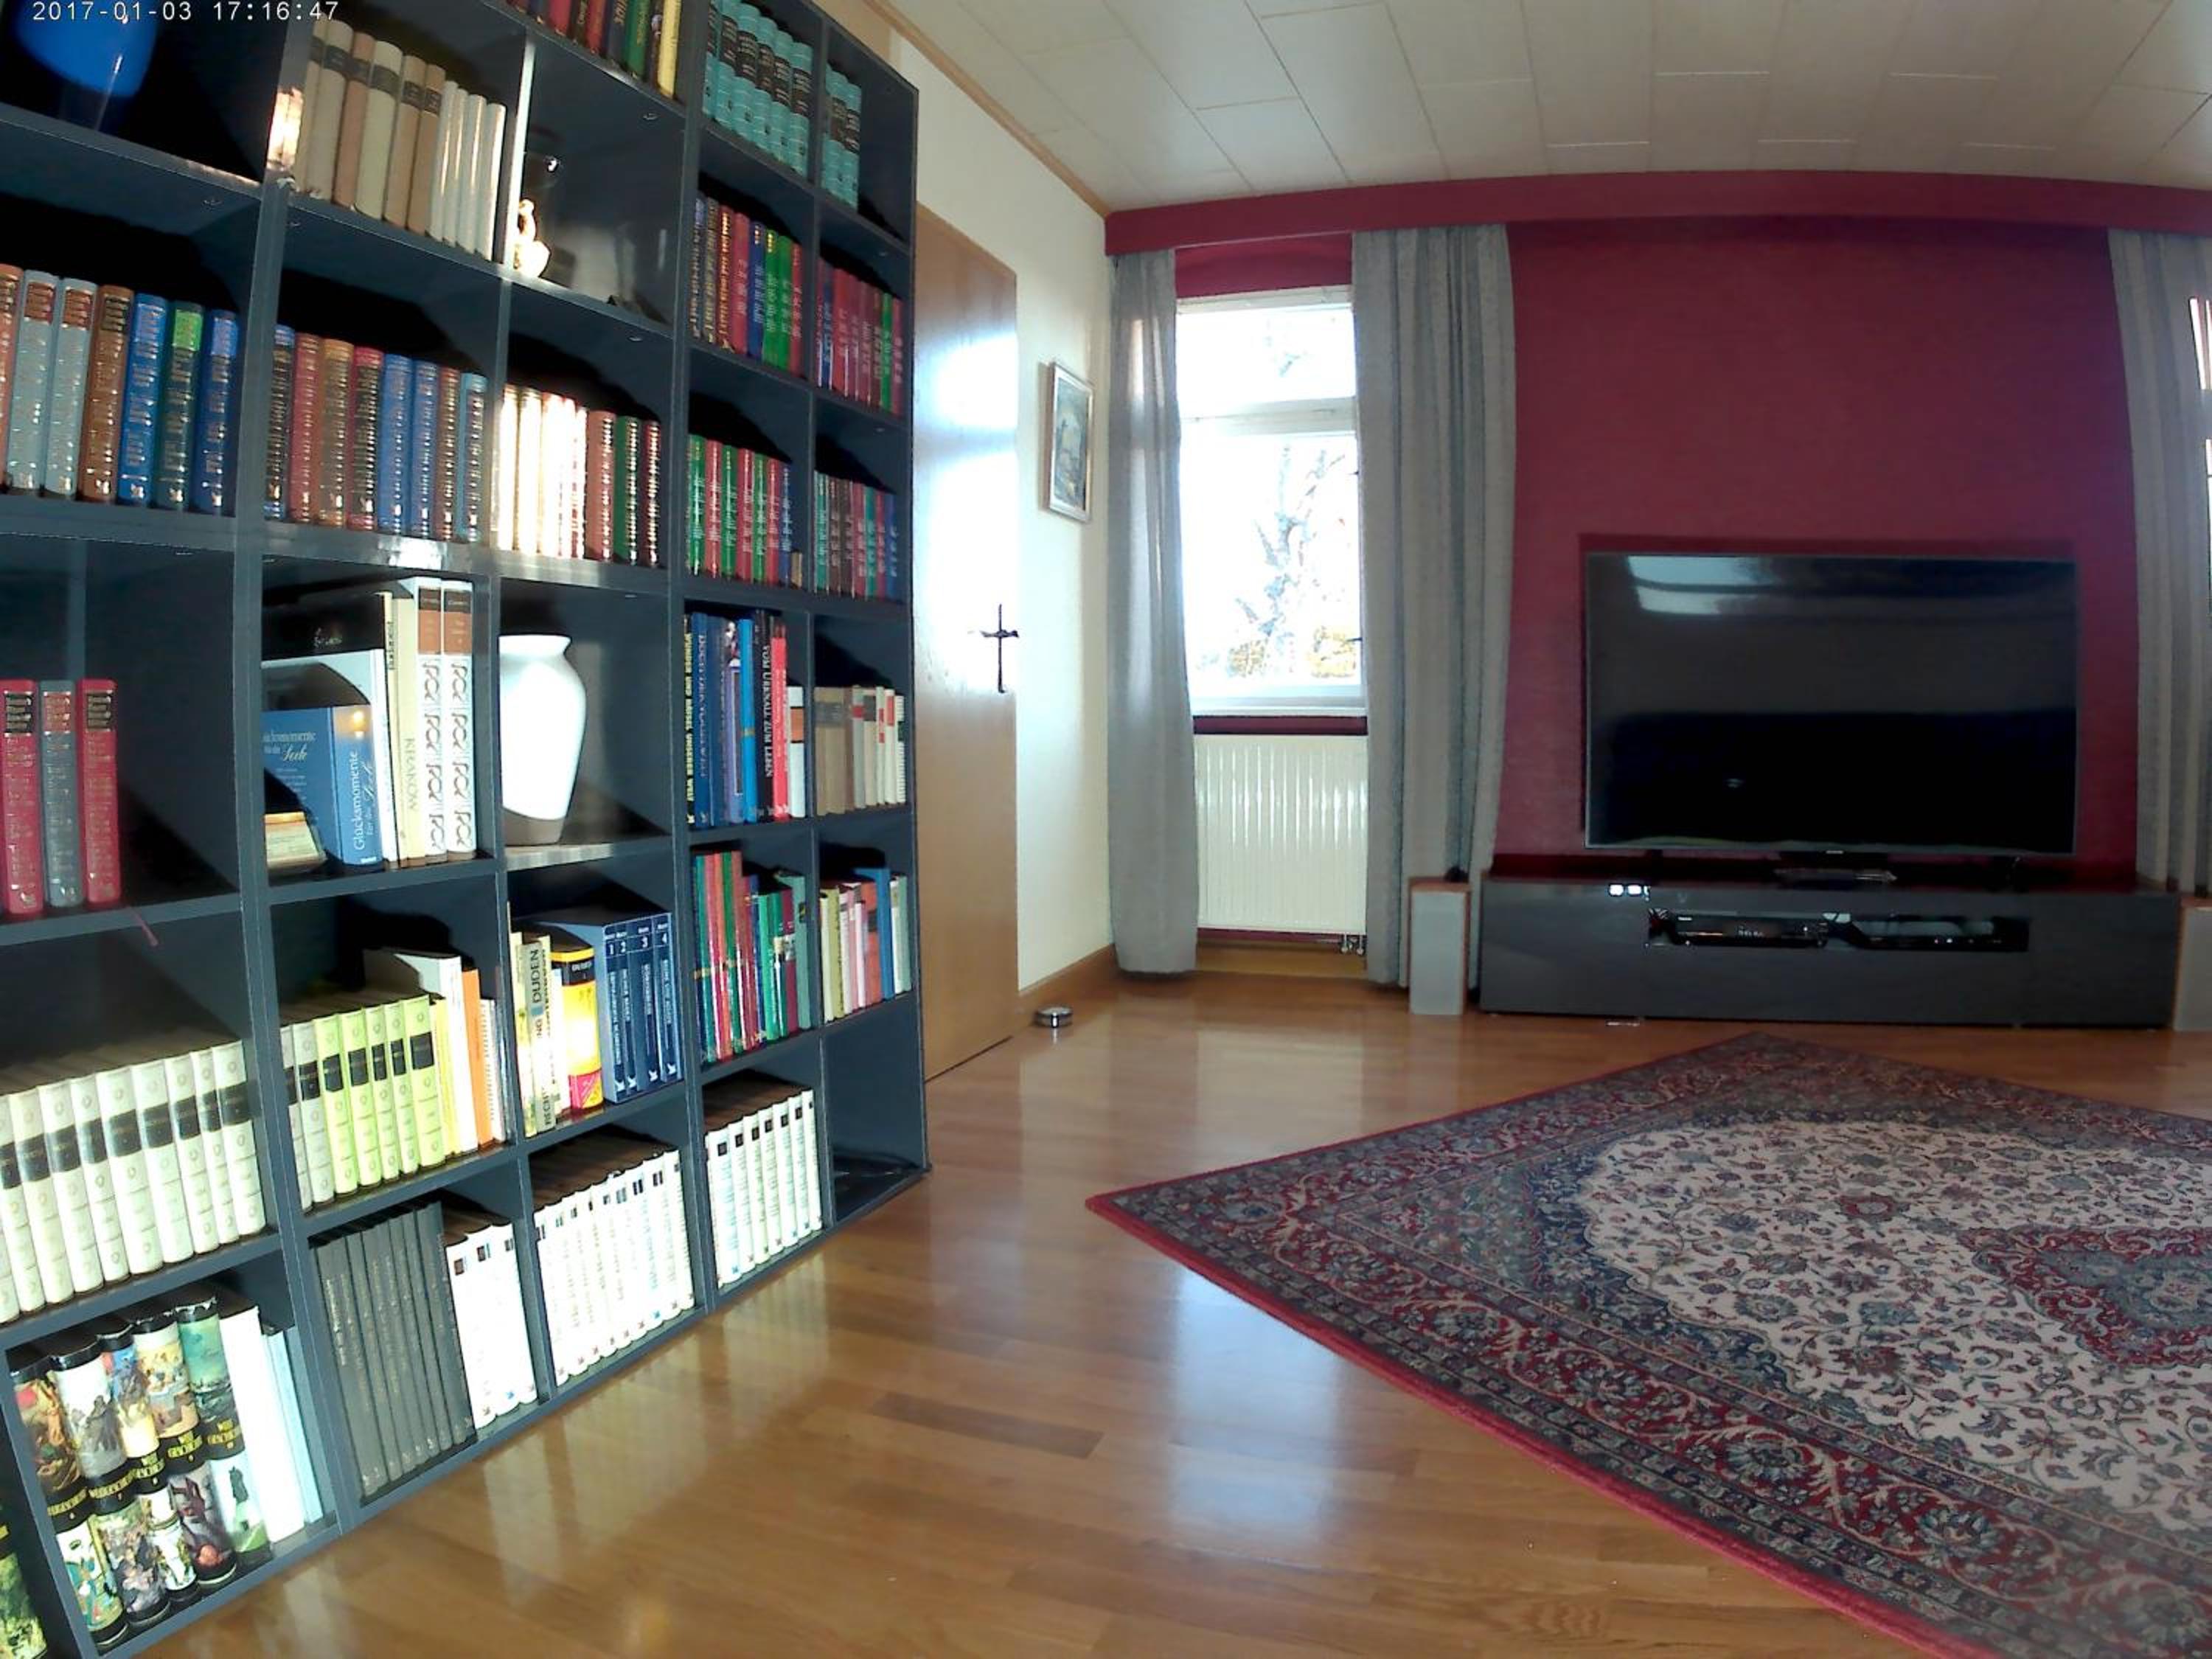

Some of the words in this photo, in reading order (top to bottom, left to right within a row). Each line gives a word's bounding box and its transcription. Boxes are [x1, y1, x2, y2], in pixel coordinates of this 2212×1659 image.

[684, 633, 693, 673] WUNDER
[762, 645, 771, 669] VOM
[684, 676, 693, 696] UND
[762, 672, 772, 717] URKNALL
[763, 720, 772, 742] ZUM
[685, 734, 695, 776] UNSERER
[764, 745, 773, 778] LEBEN
[686, 778, 695, 801] WELT
[608, 944, 614, 956] 1
[529, 948, 542, 1004] DUDEN
